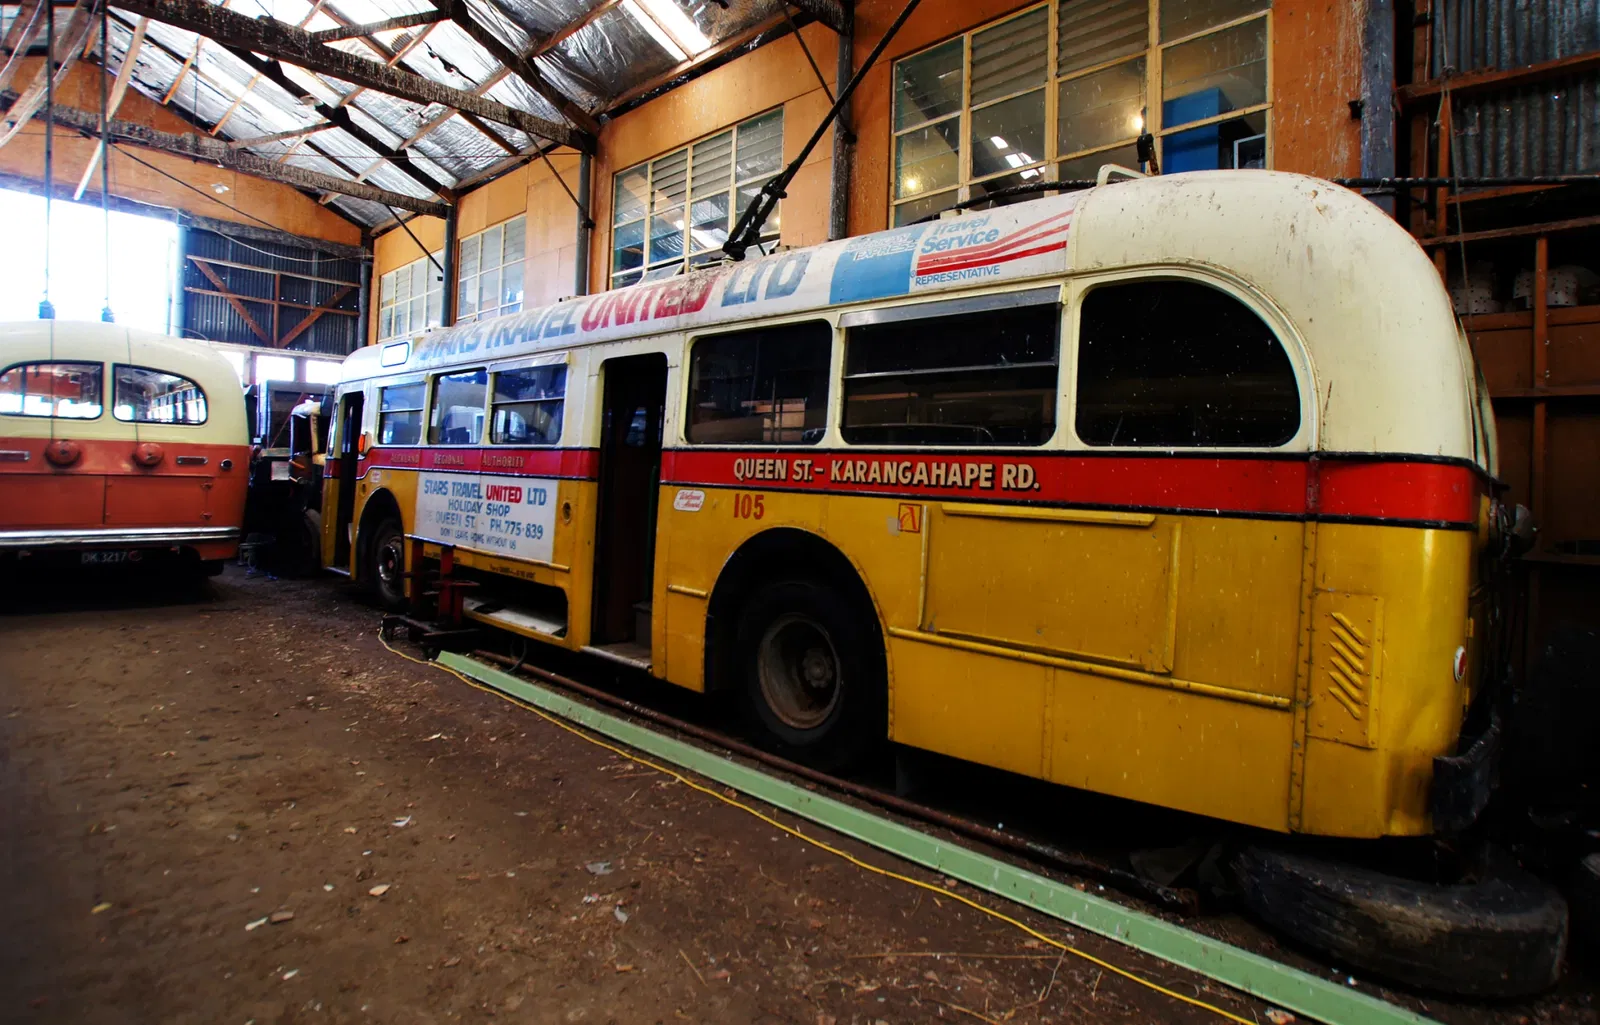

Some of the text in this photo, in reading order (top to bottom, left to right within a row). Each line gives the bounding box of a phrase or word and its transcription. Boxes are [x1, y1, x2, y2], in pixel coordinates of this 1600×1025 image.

[932, 213, 992, 236] Travel
[852, 242, 918, 262] EXPRESS
[921, 228, 1000, 254] Service
[915, 264, 1000, 286] REPRESENTATIVE
[486, 303, 578, 349] TRAVEL
[580, 272, 720, 333] UNITED
[721, 251, 813, 307] LTD
[433, 452, 465, 466] REGIONAL
[482, 454, 525, 469] AUTHORITY
[733, 457, 787, 482] QUEEN
[830, 459, 995, 490] KARANGAHAPE
[1001, 463, 1042, 492] RD.
[423, 479, 547, 506] STARS TRAVEL UNITED LTD
[448, 498, 511, 518] HOLIDAY SHOP
[733, 492, 765, 521] 105
[435, 510, 462, 527] QUEEN
[470, 532, 485, 545] HOME
[486, 534, 508, 549] WITHOUT
[509, 539, 517, 550] US
